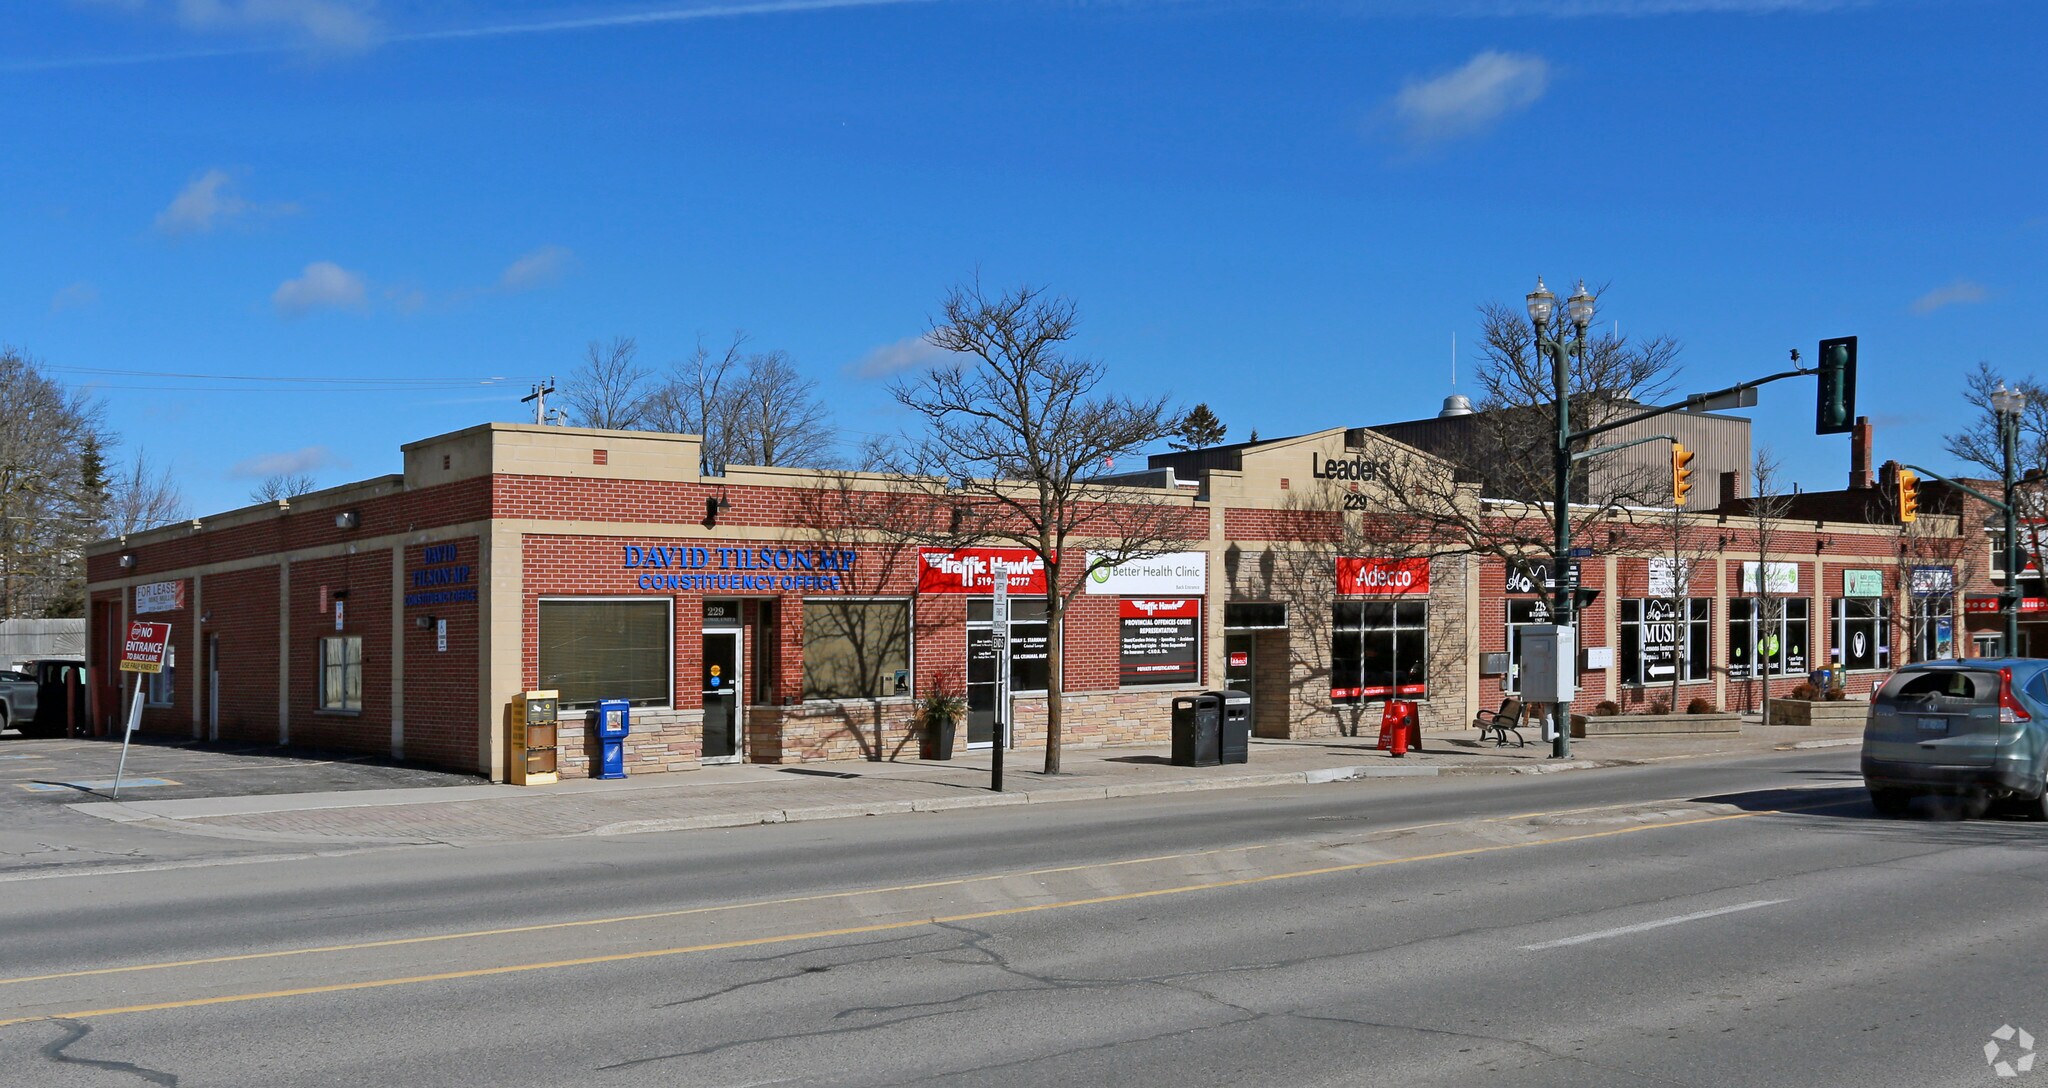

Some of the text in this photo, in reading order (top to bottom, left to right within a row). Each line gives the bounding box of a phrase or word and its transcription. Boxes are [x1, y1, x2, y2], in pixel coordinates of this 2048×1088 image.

[1313, 452, 1390, 481] Leaders
[1344, 494, 1367, 510] 229
[424, 544, 458, 565] DAVID
[624, 546, 857, 572] DAVID TILSON MP
[941, 556, 1034, 586] Traffic Hawk
[1650, 559, 1664, 568] FOR
[412, 566, 470, 587] TILSON MP
[1112, 566, 1200, 577] Better Health Clinic
[1356, 566, 1412, 587] Adecco
[638, 574, 840, 590] CONSTITUENCY OFFICE
[977, 577, 1030, 586] 519--8777
[138, 582, 175, 597] FOR LEASE
[454, 589, 478, 602] OFFICE
[707, 607, 724, 616] 229
[1140, 602, 1158, 616] Traffic
[141, 628, 152, 637] NO
[1644, 624, 1684, 642] MUSIC
[126, 642, 162, 653] ENTRANCE
[994, 639, 1004, 648] ENDS
